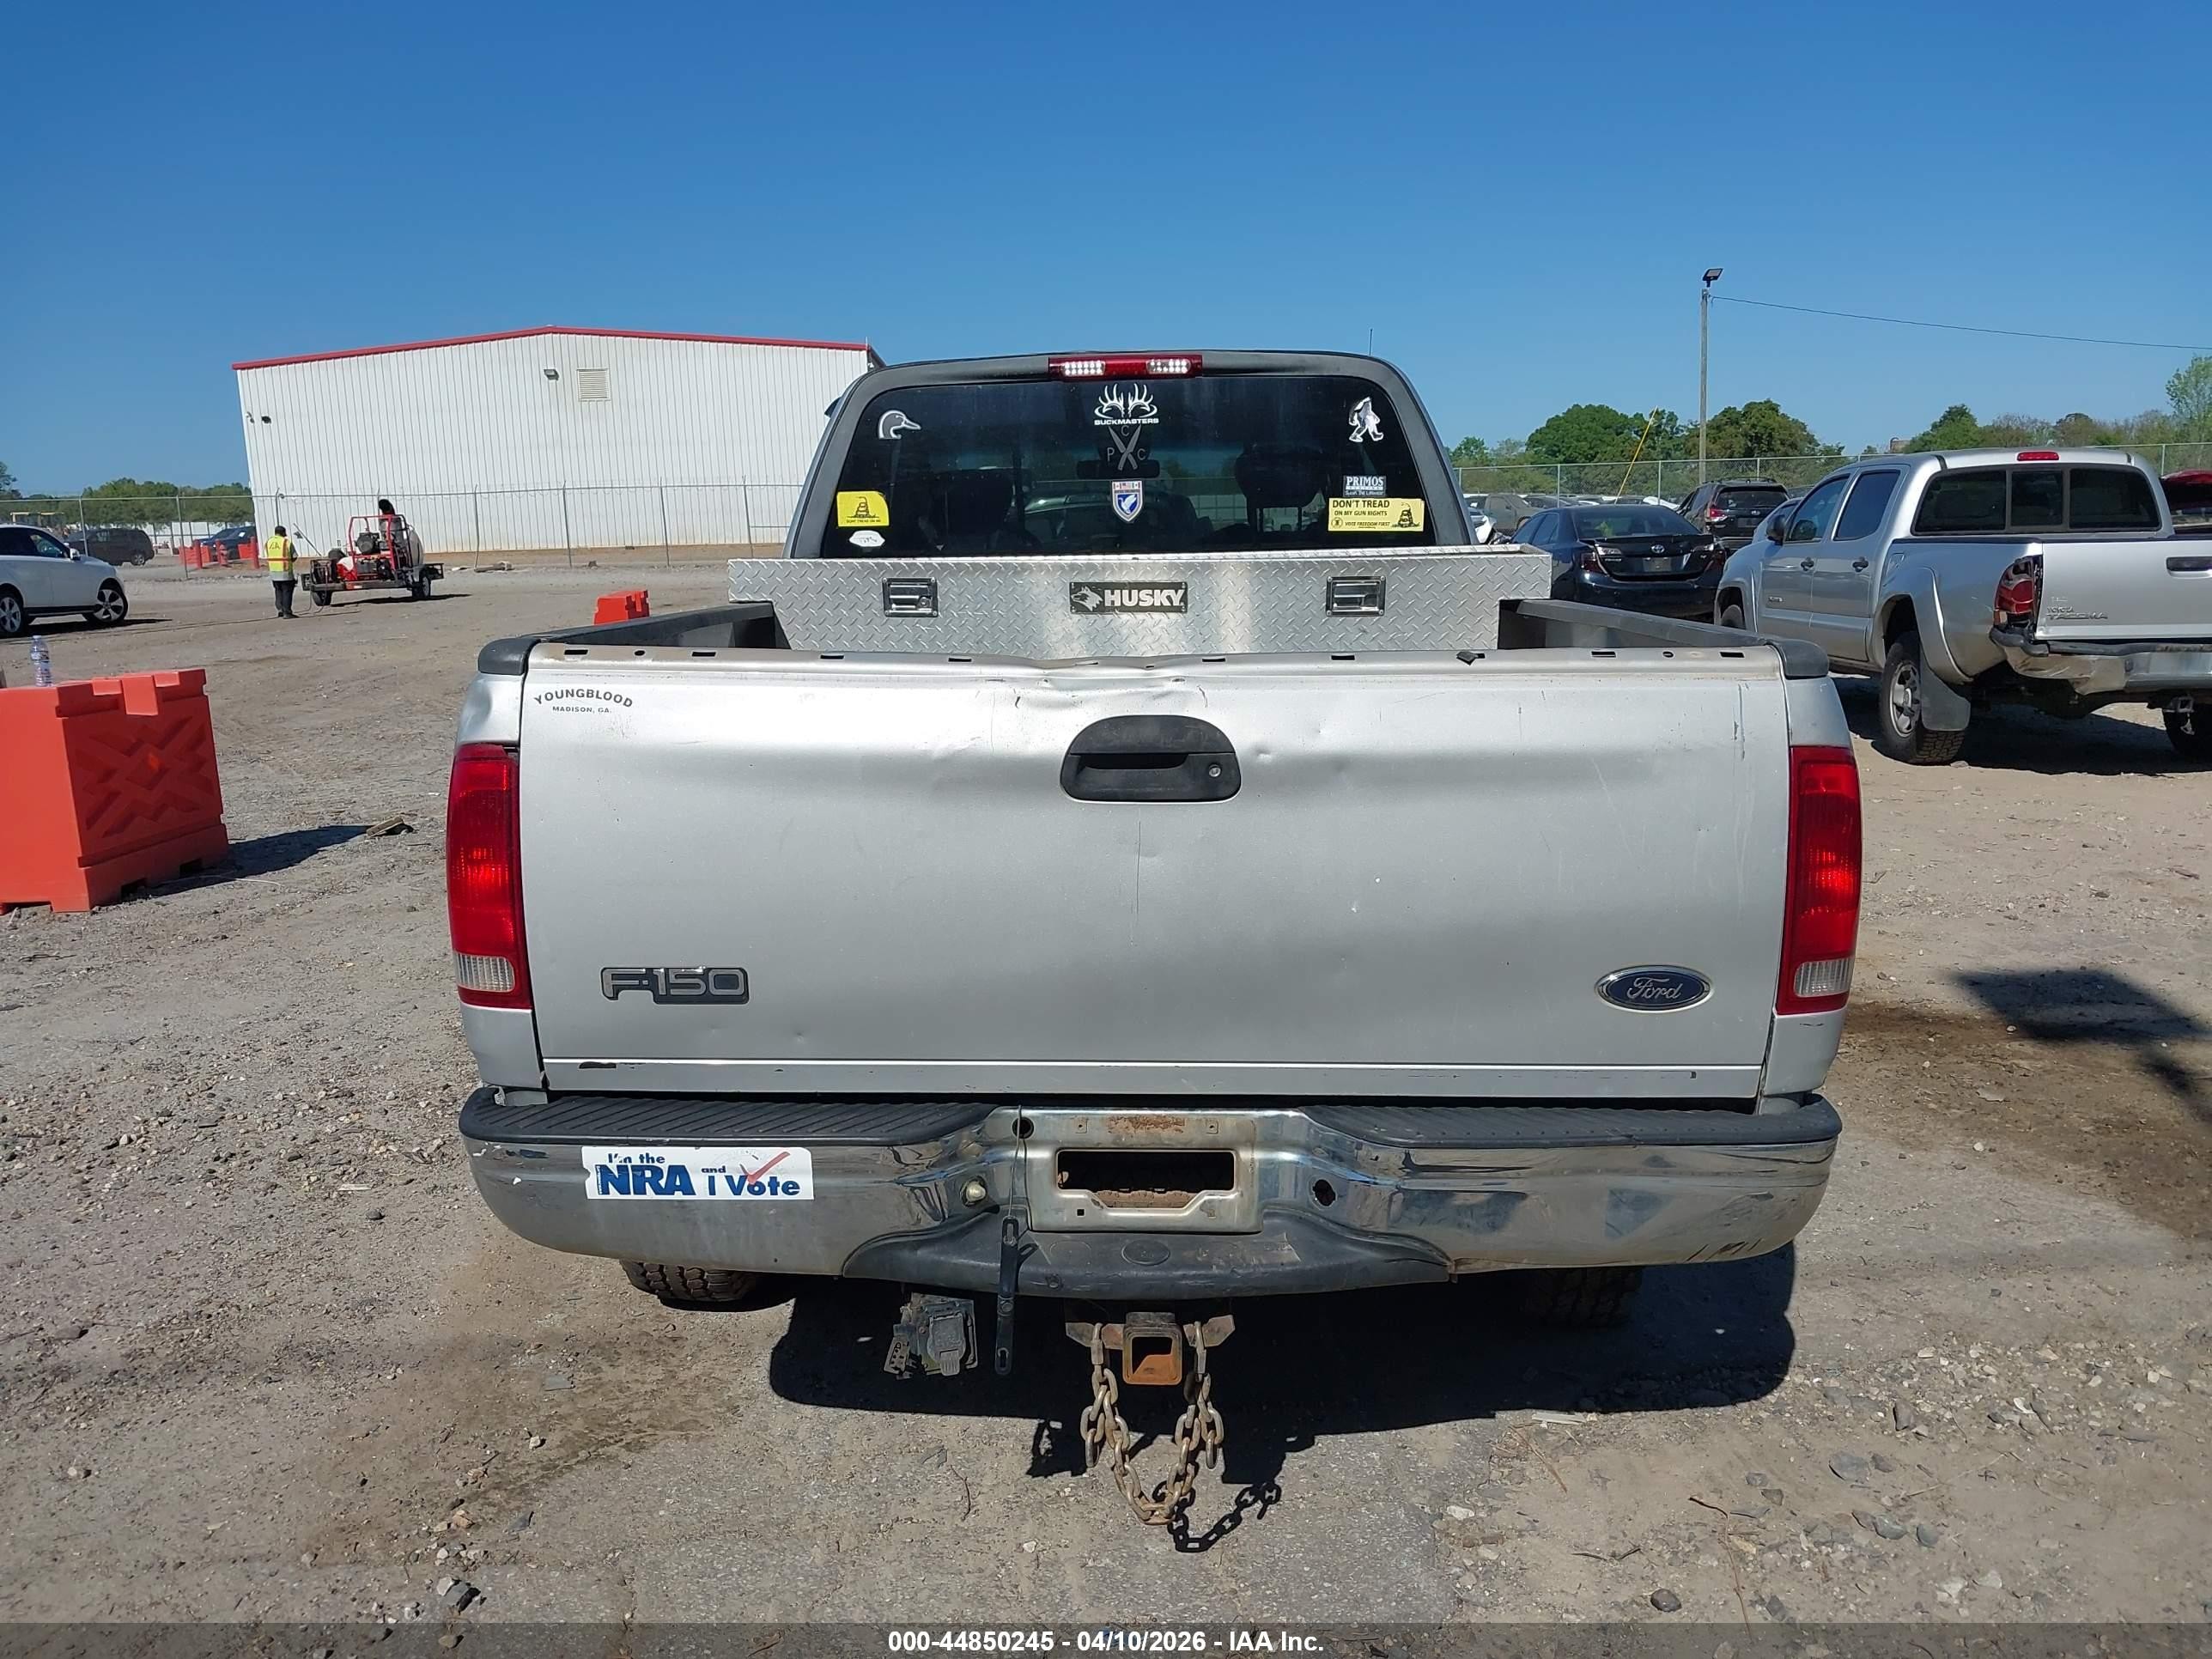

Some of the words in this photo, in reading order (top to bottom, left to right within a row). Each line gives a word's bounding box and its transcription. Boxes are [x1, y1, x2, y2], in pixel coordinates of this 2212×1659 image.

[1121, 425, 1129, 436] C
[1107, 447, 1115, 462] P
[1137, 448, 1146, 460] C
[1346, 476, 1384, 487] PRIMOS
[1104, 589, 1185, 606] HUSKY
[534, 689, 633, 708] YOUNGBLOOD
[602, 968, 745, 998] F-150
[1626, 976, 1683, 1000] Ford
[639, 1152, 665, 1164] the
[701, 1165, 726, 1174] and
[594, 1164, 696, 1196] NRA
[708, 1175, 716, 1196] I
[725, 1175, 800, 1196] Vote
